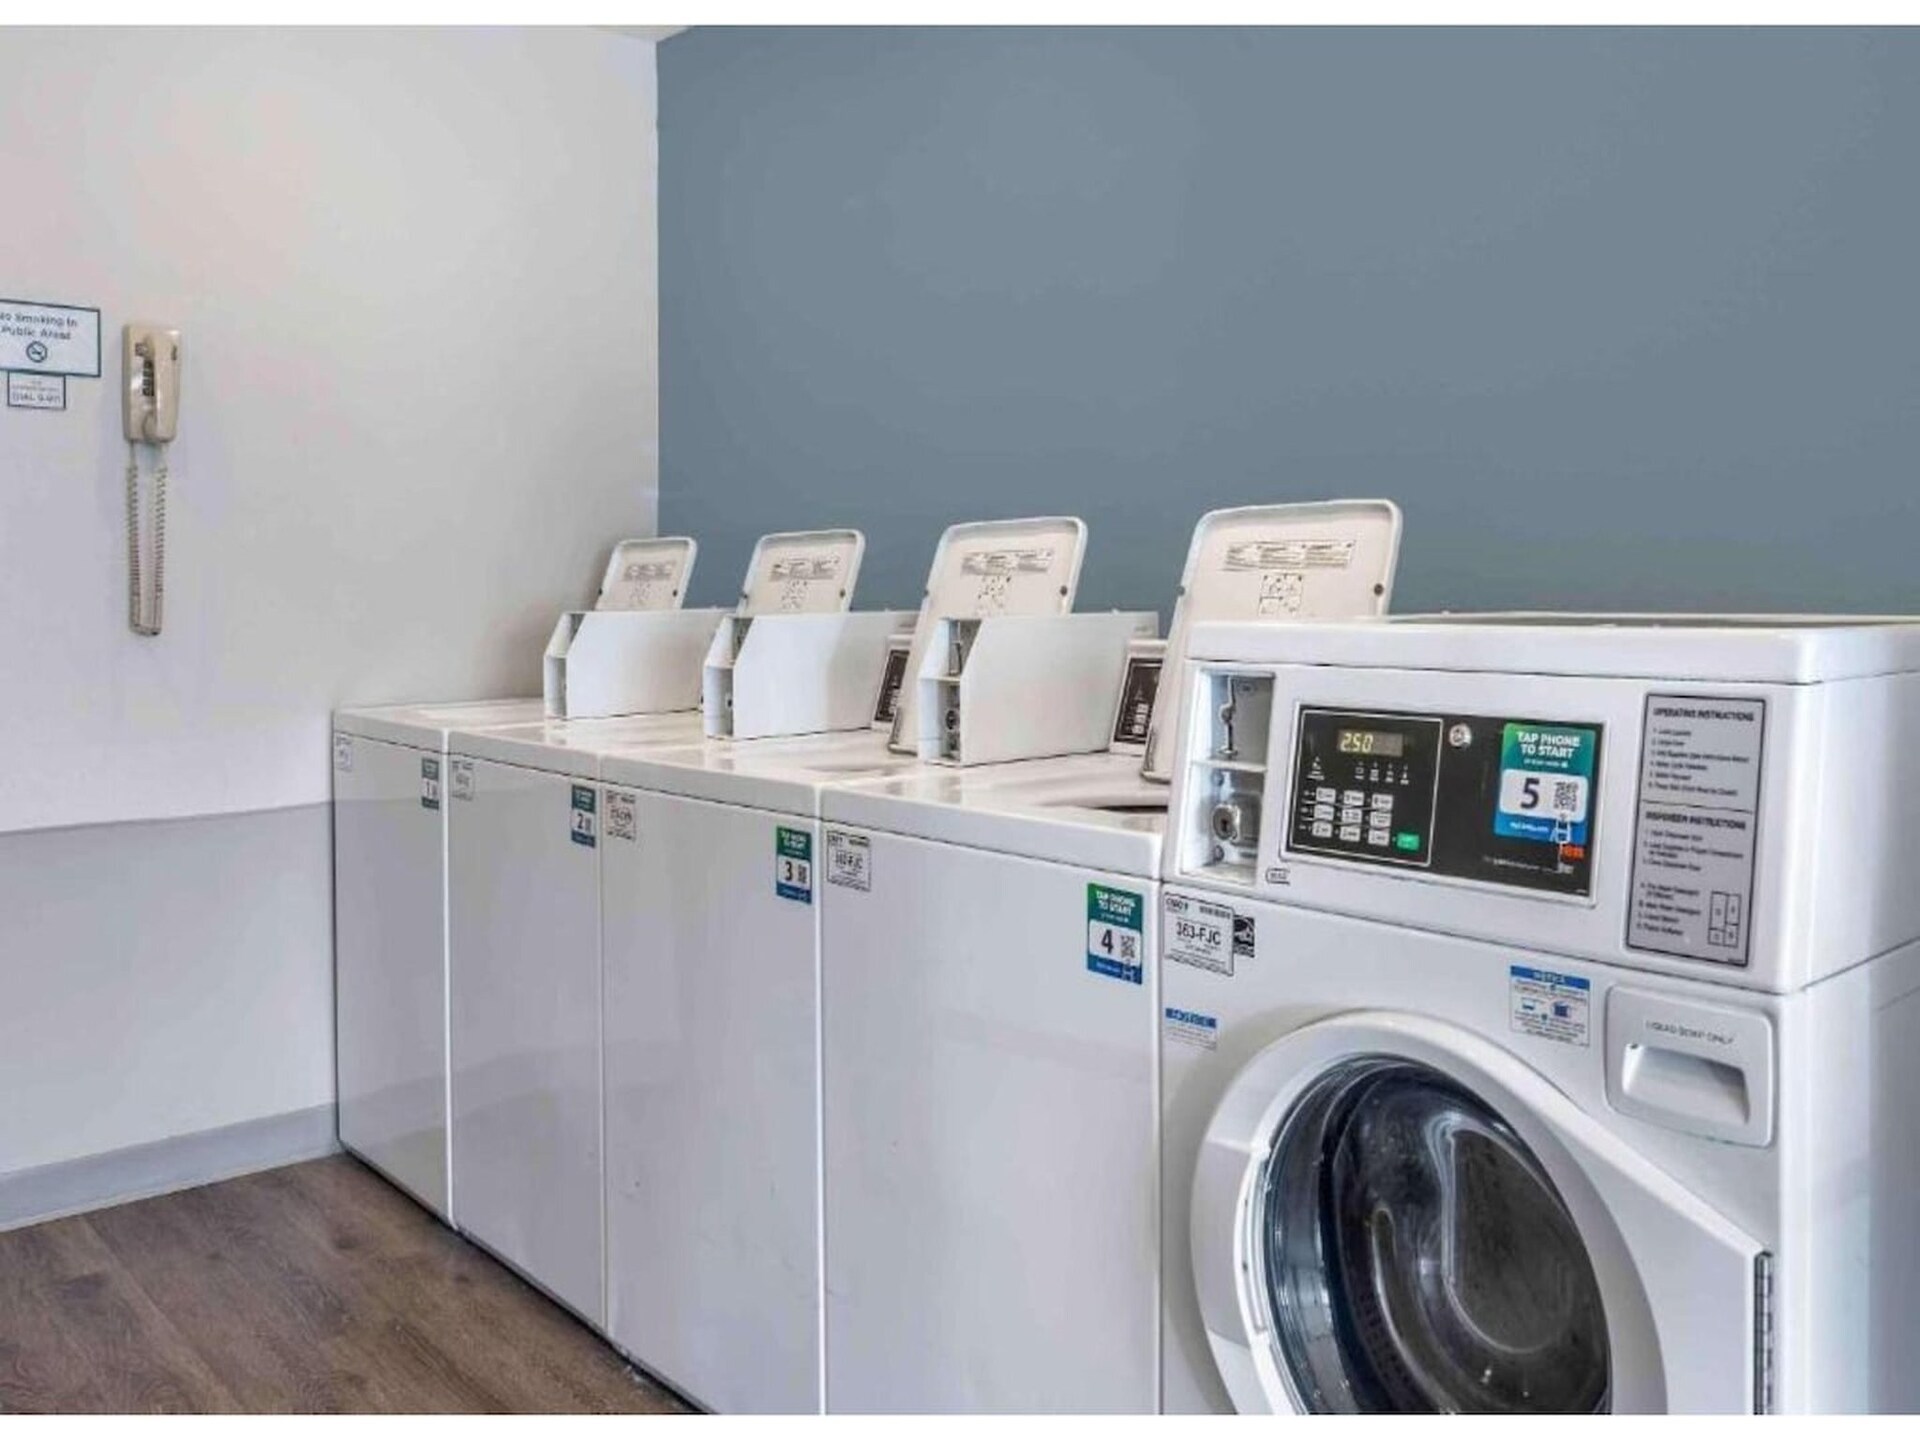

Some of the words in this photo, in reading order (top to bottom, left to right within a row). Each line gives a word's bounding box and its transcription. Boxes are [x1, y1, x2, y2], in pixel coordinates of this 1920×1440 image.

[1, 326, 36, 336] Public
[1516, 731, 1539, 744] TAP
[1540, 734, 1580, 747] PHONE
[1520, 743, 1536, 755] TO
[1538, 746, 1574, 759] START
[1520, 777, 1541, 810] 5
[784, 860, 793, 882] 3
[1100, 928, 1114, 954] 4
